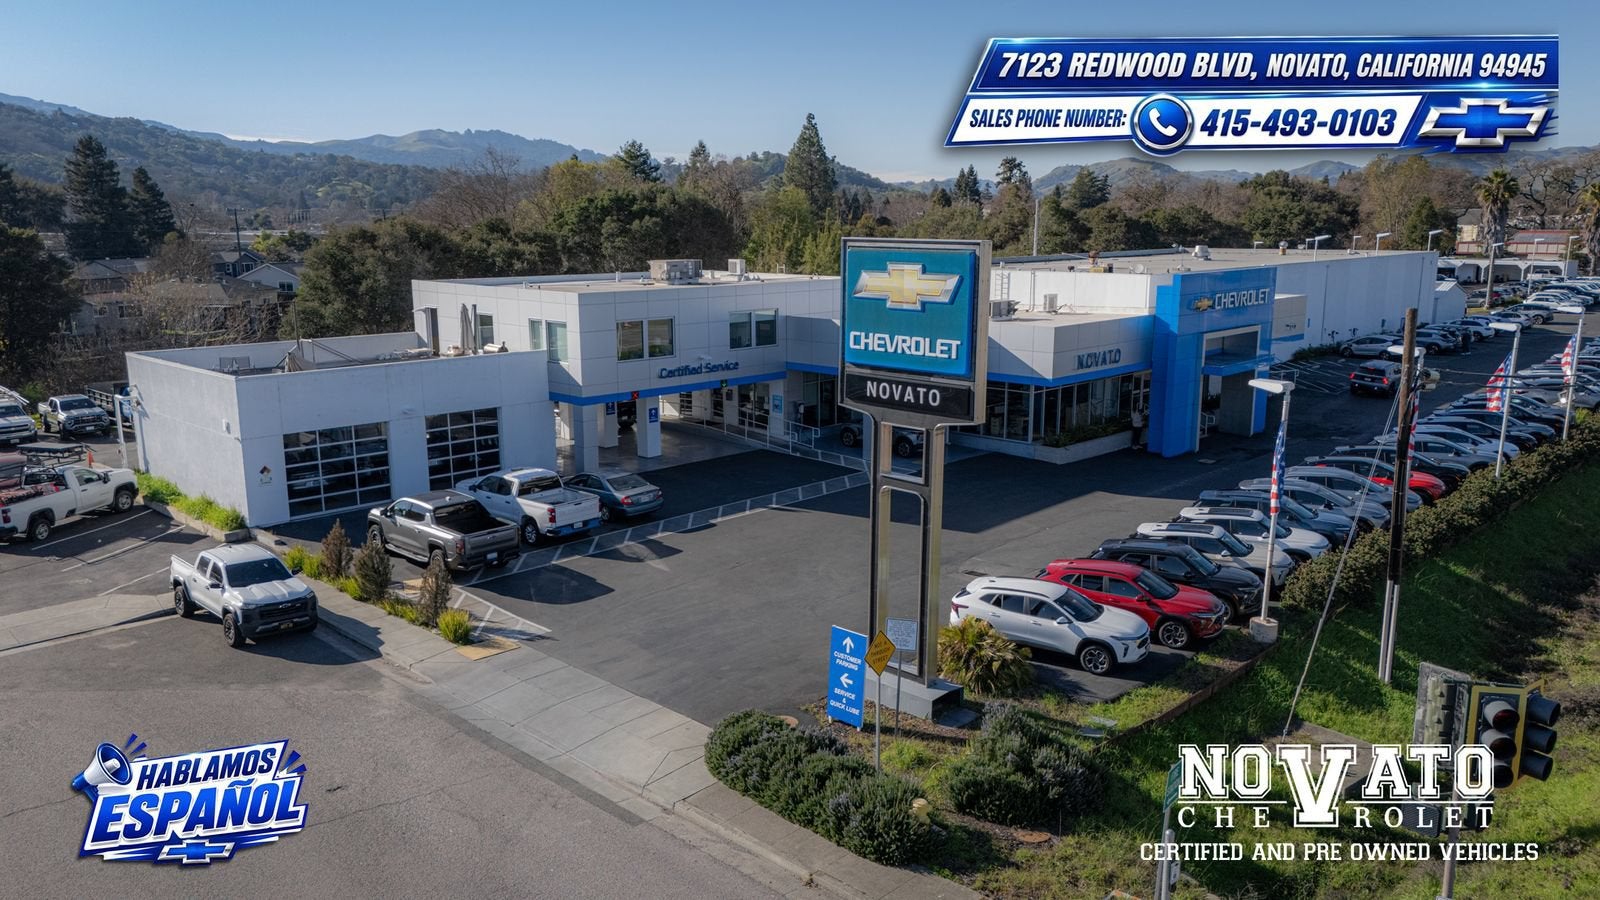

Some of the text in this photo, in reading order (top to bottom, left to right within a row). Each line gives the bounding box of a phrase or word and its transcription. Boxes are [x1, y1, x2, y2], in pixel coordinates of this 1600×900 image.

[1215, 288, 1270, 310] CHEVROLET
[850, 331, 961, 359] CHEVROLET
[1075, 348, 1121, 370] NOVATO
[658, 360, 739, 379] Certified Service
[866, 380, 940, 407] NOVATO
[834, 651, 861, 665] CUSTOMER
[836, 659, 858, 671] PARKING
[834, 687, 856, 699] SERVICE
[829, 700, 860, 716] QUICK LUBE
